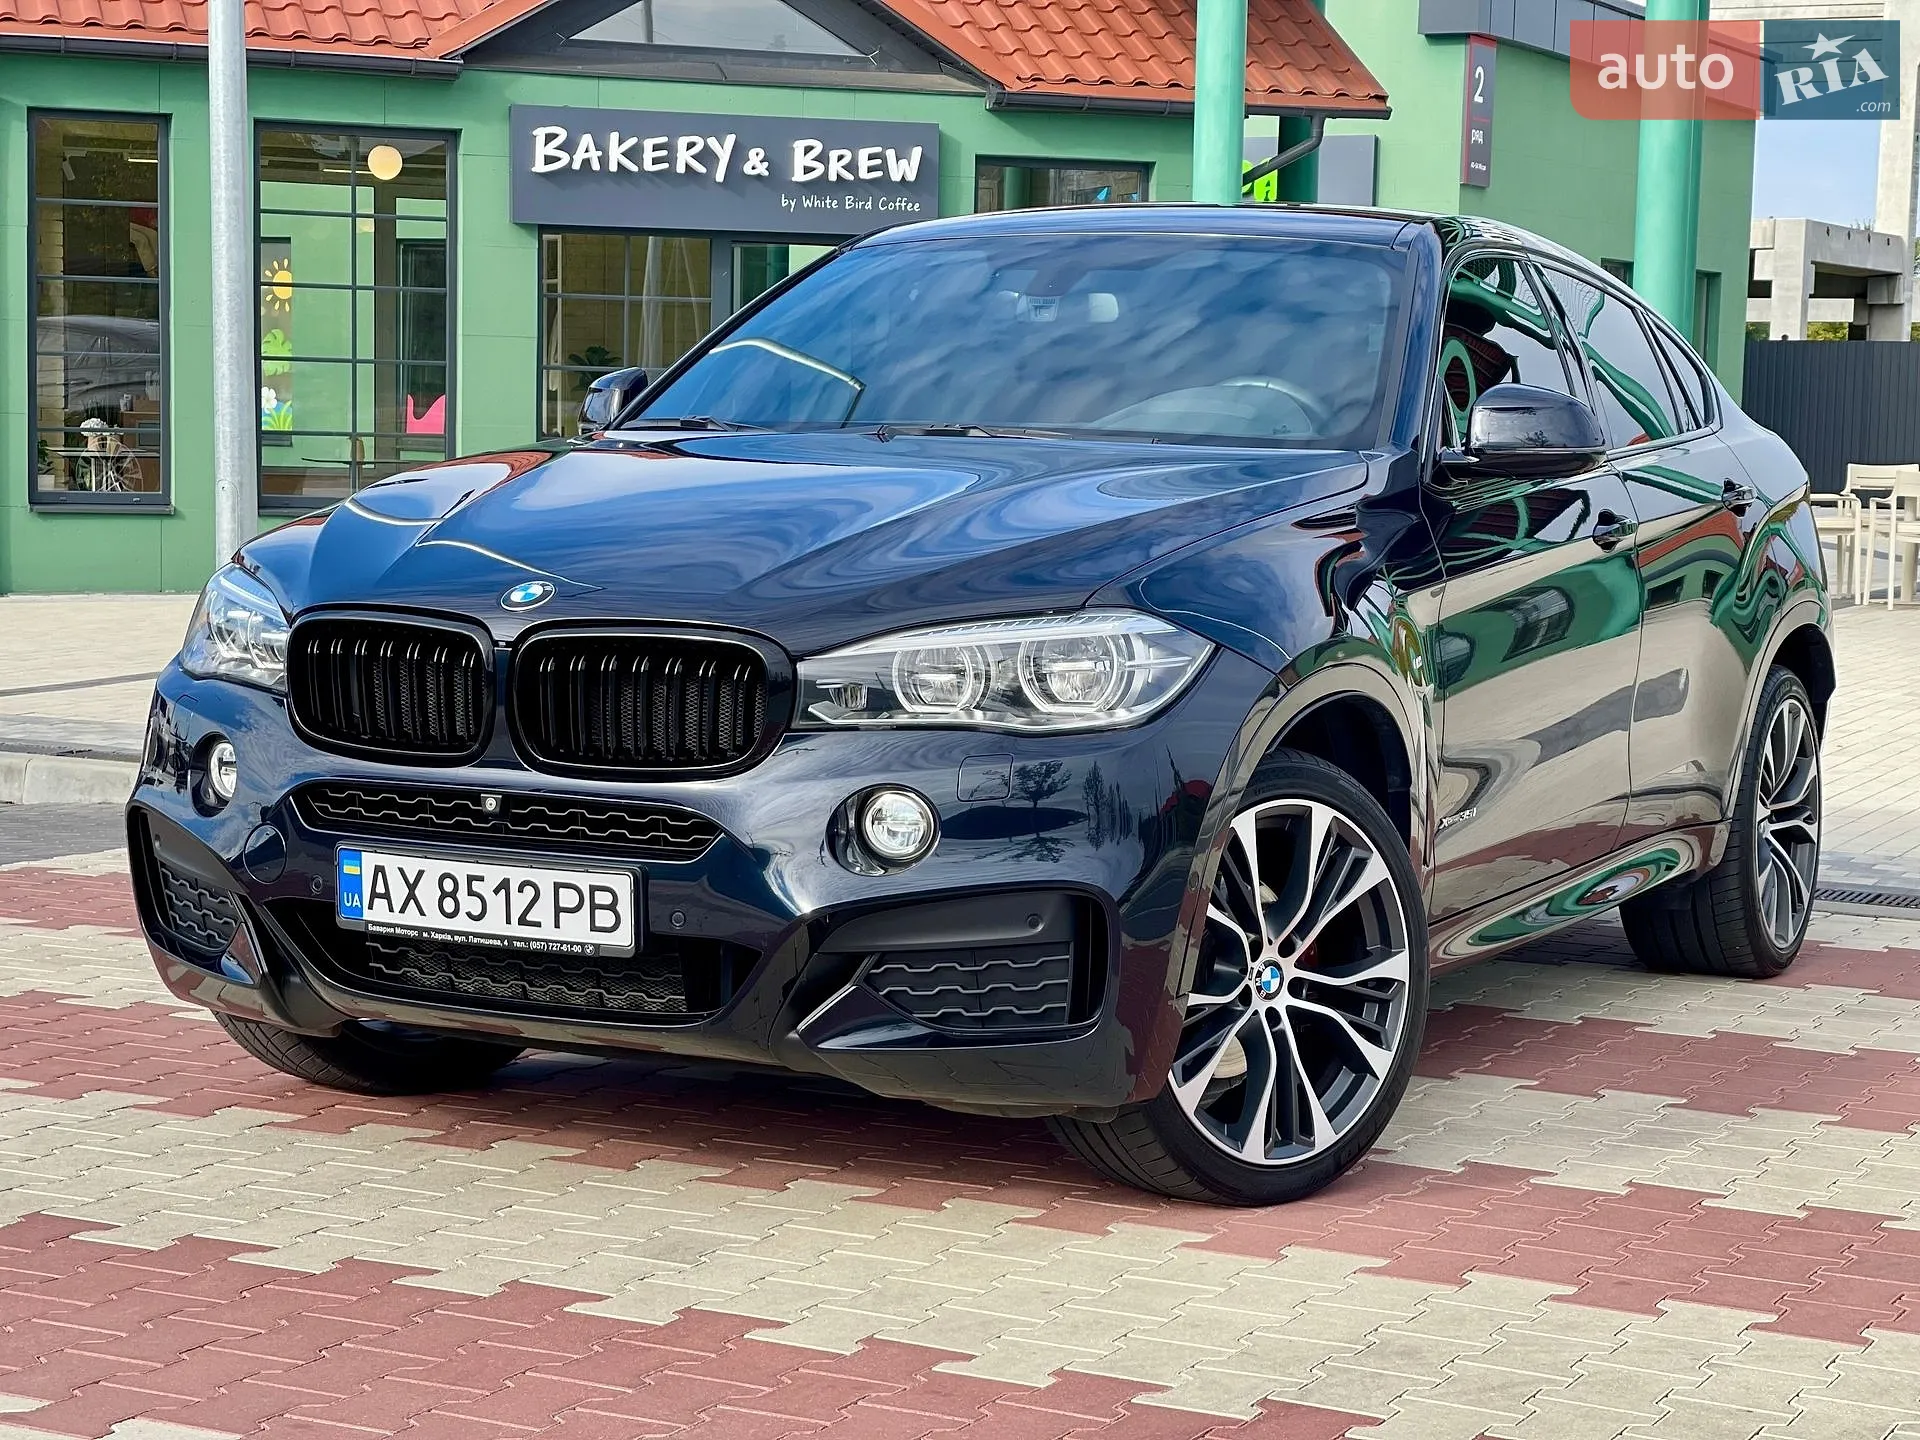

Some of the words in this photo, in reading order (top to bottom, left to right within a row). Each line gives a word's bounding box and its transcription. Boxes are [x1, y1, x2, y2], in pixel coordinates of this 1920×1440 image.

[1473, 65, 1485, 104] 2
[743, 147, 770, 176] &
[781, 193, 797, 213] by
[802, 195, 839, 209] White
[844, 195, 873, 210] Bird
[878, 197, 921, 212] Coffee
[343, 891, 362, 908] UA
[367, 864, 427, 916] AX
[437, 871, 542, 928] 8512
[553, 881, 622, 933] PB
[530, 940, 548, 951] (057)
[548, 942, 582, 953] 727-61-00
